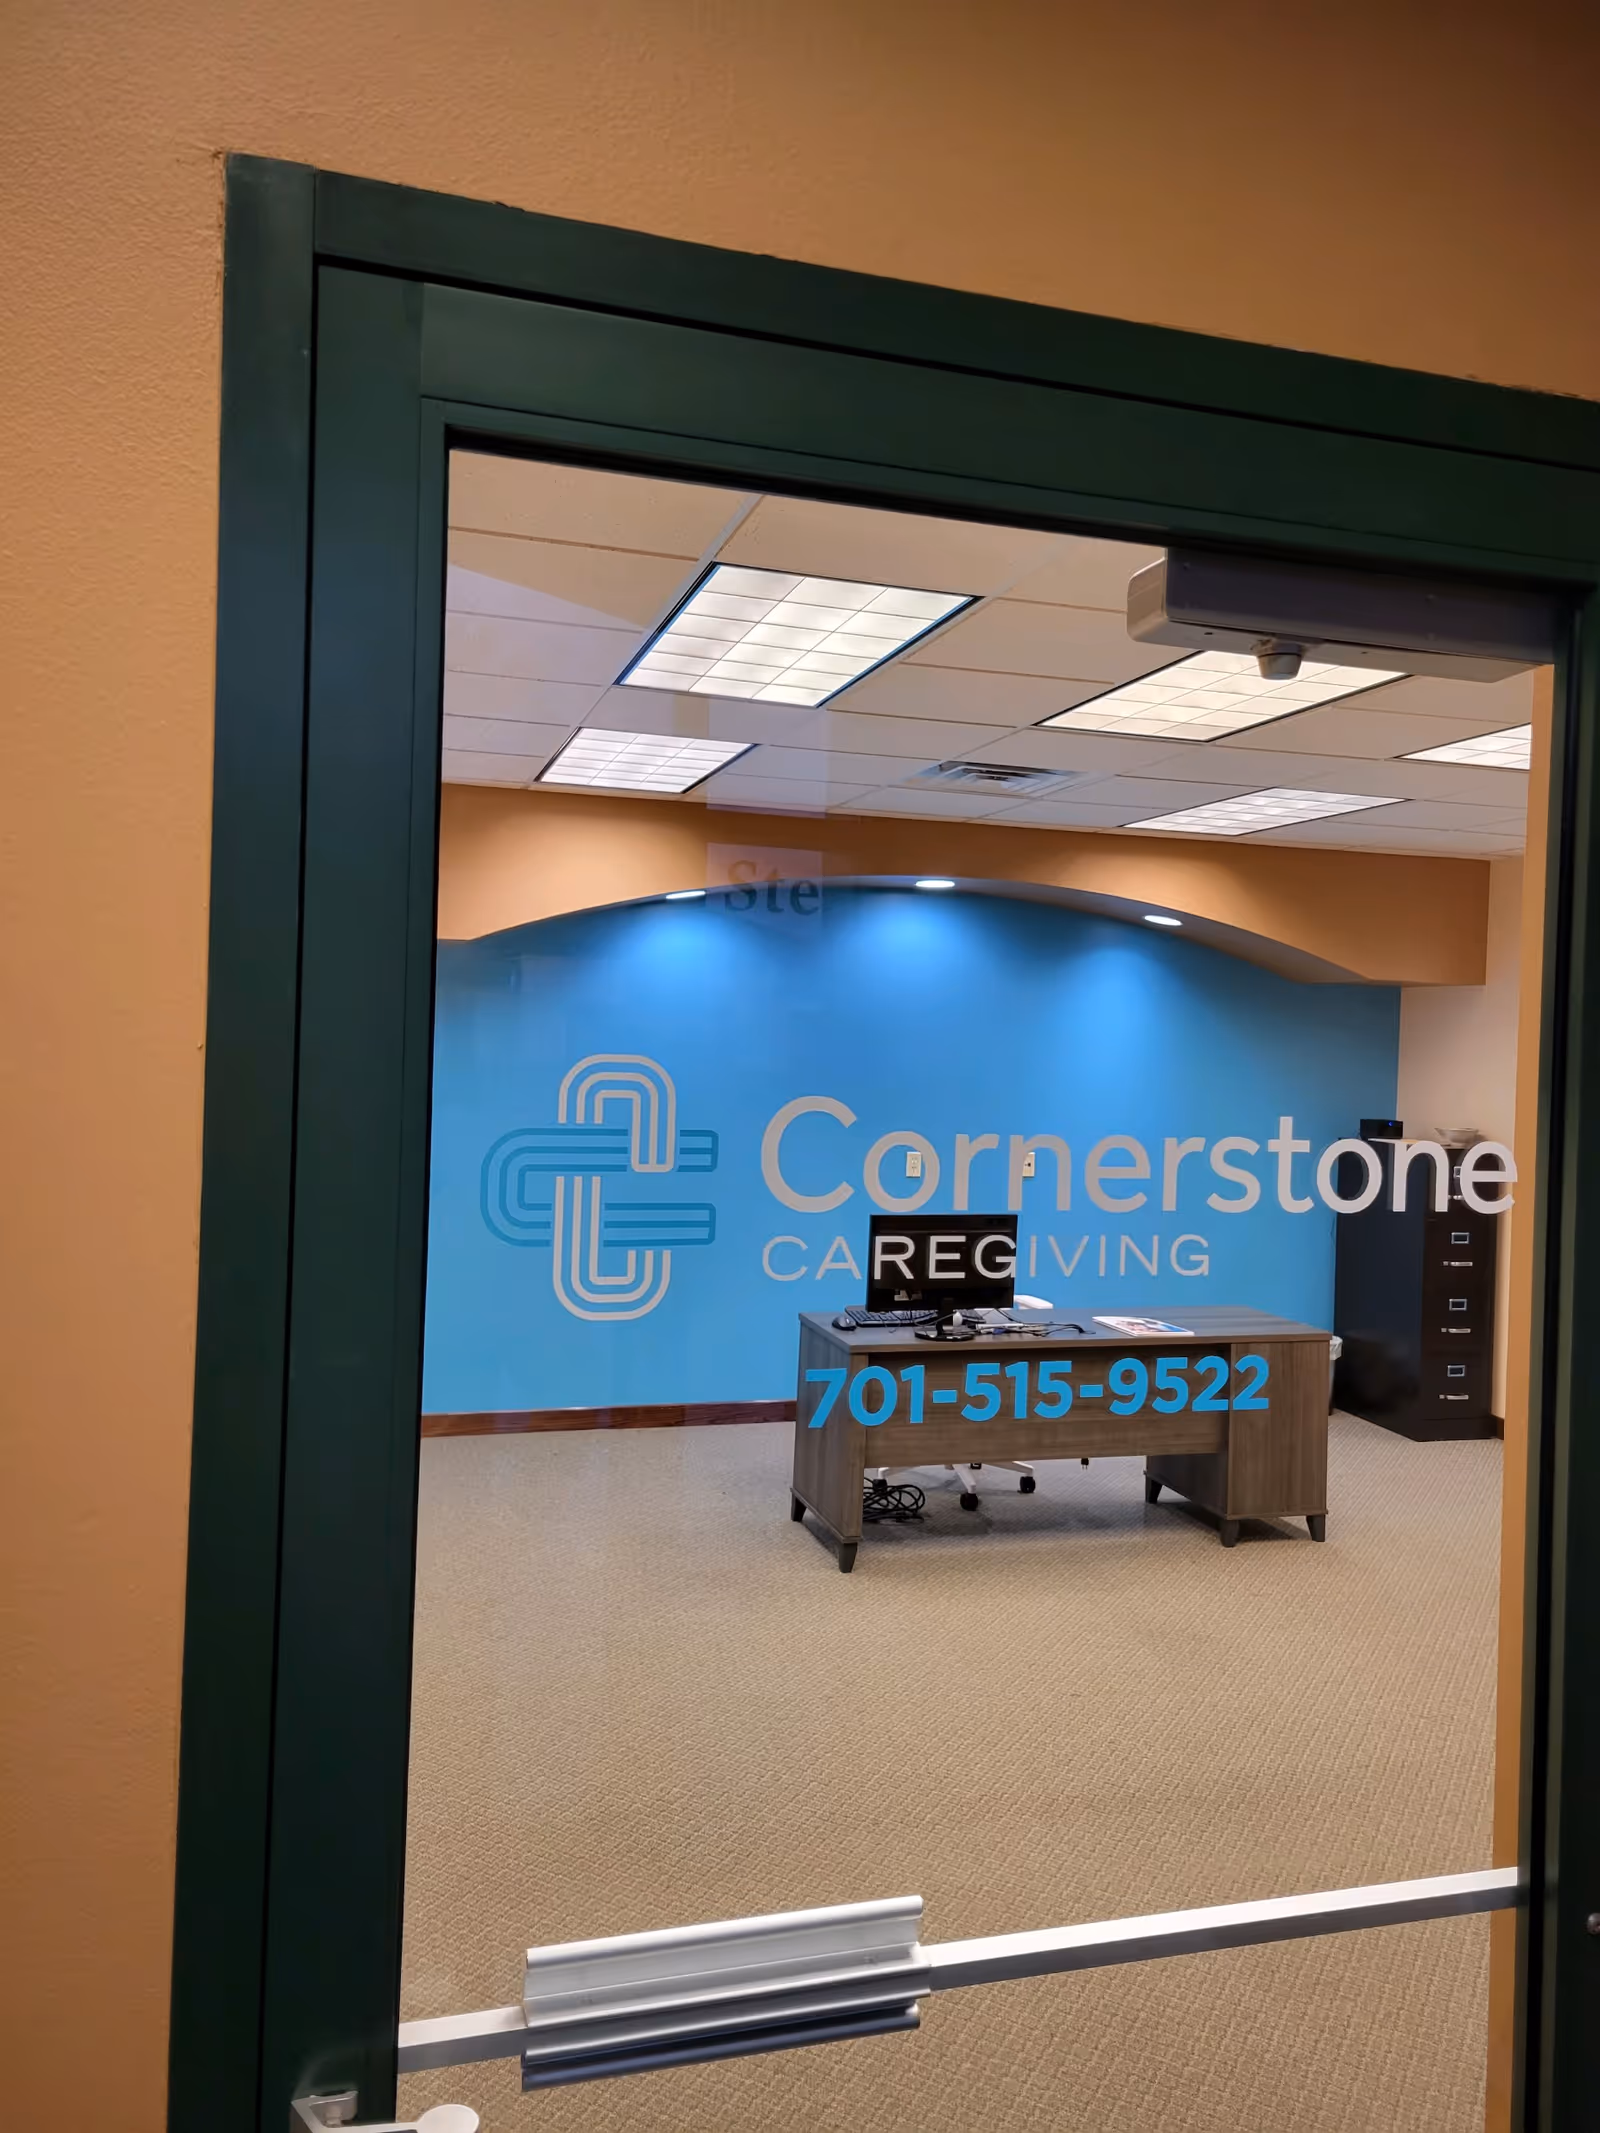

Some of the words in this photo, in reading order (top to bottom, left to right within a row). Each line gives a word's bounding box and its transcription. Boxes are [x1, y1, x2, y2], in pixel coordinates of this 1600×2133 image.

[725, 859, 820, 916] Ste
[761, 1095, 1517, 1214] Cornerstone
[762, 1233, 1210, 1283] CAREGIVING
[805, 1354, 1270, 1429] 701-515-9522
